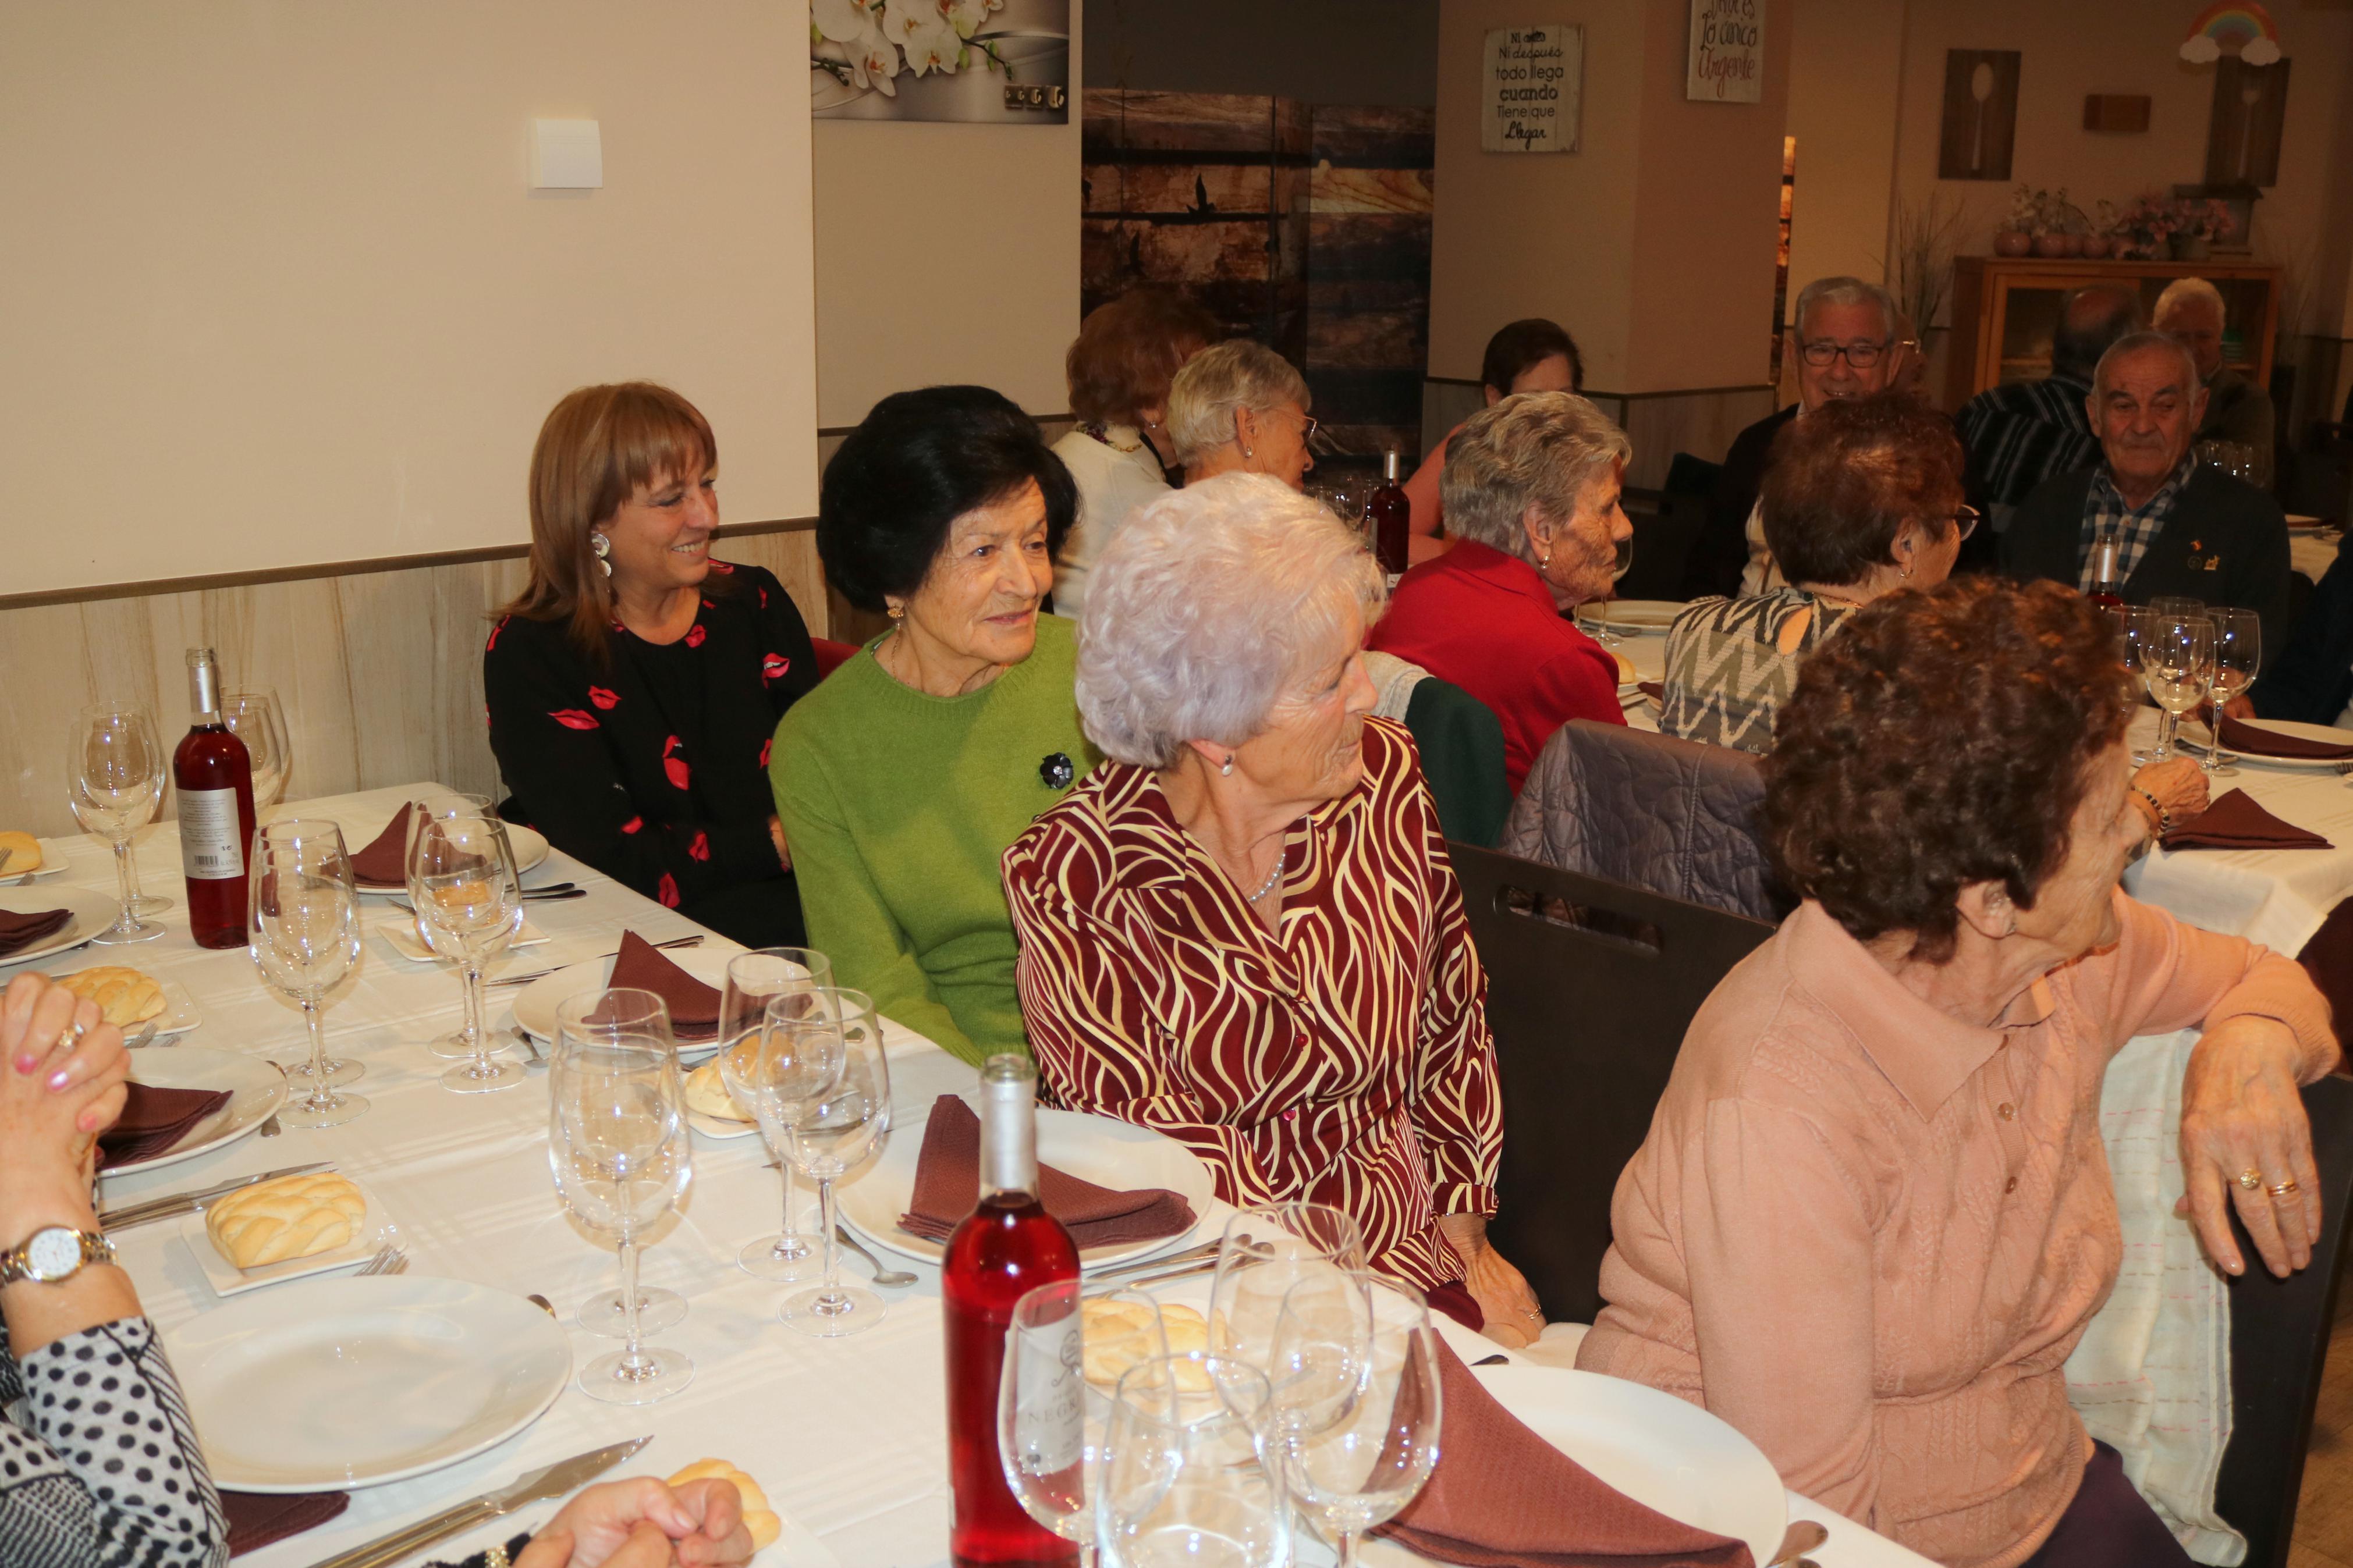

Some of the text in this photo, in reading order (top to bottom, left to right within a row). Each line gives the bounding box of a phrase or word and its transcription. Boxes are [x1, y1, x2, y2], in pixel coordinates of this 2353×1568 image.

[1499, 45, 1564, 64] Ni después
[1496, 65, 1564, 82] todo llega
[1698, 47, 1755, 99] Urgente
[1499, 84, 1559, 101] cuando
[1496, 105, 1555, 120] Tiene que
[1504, 120, 1546, 150] Llegar
